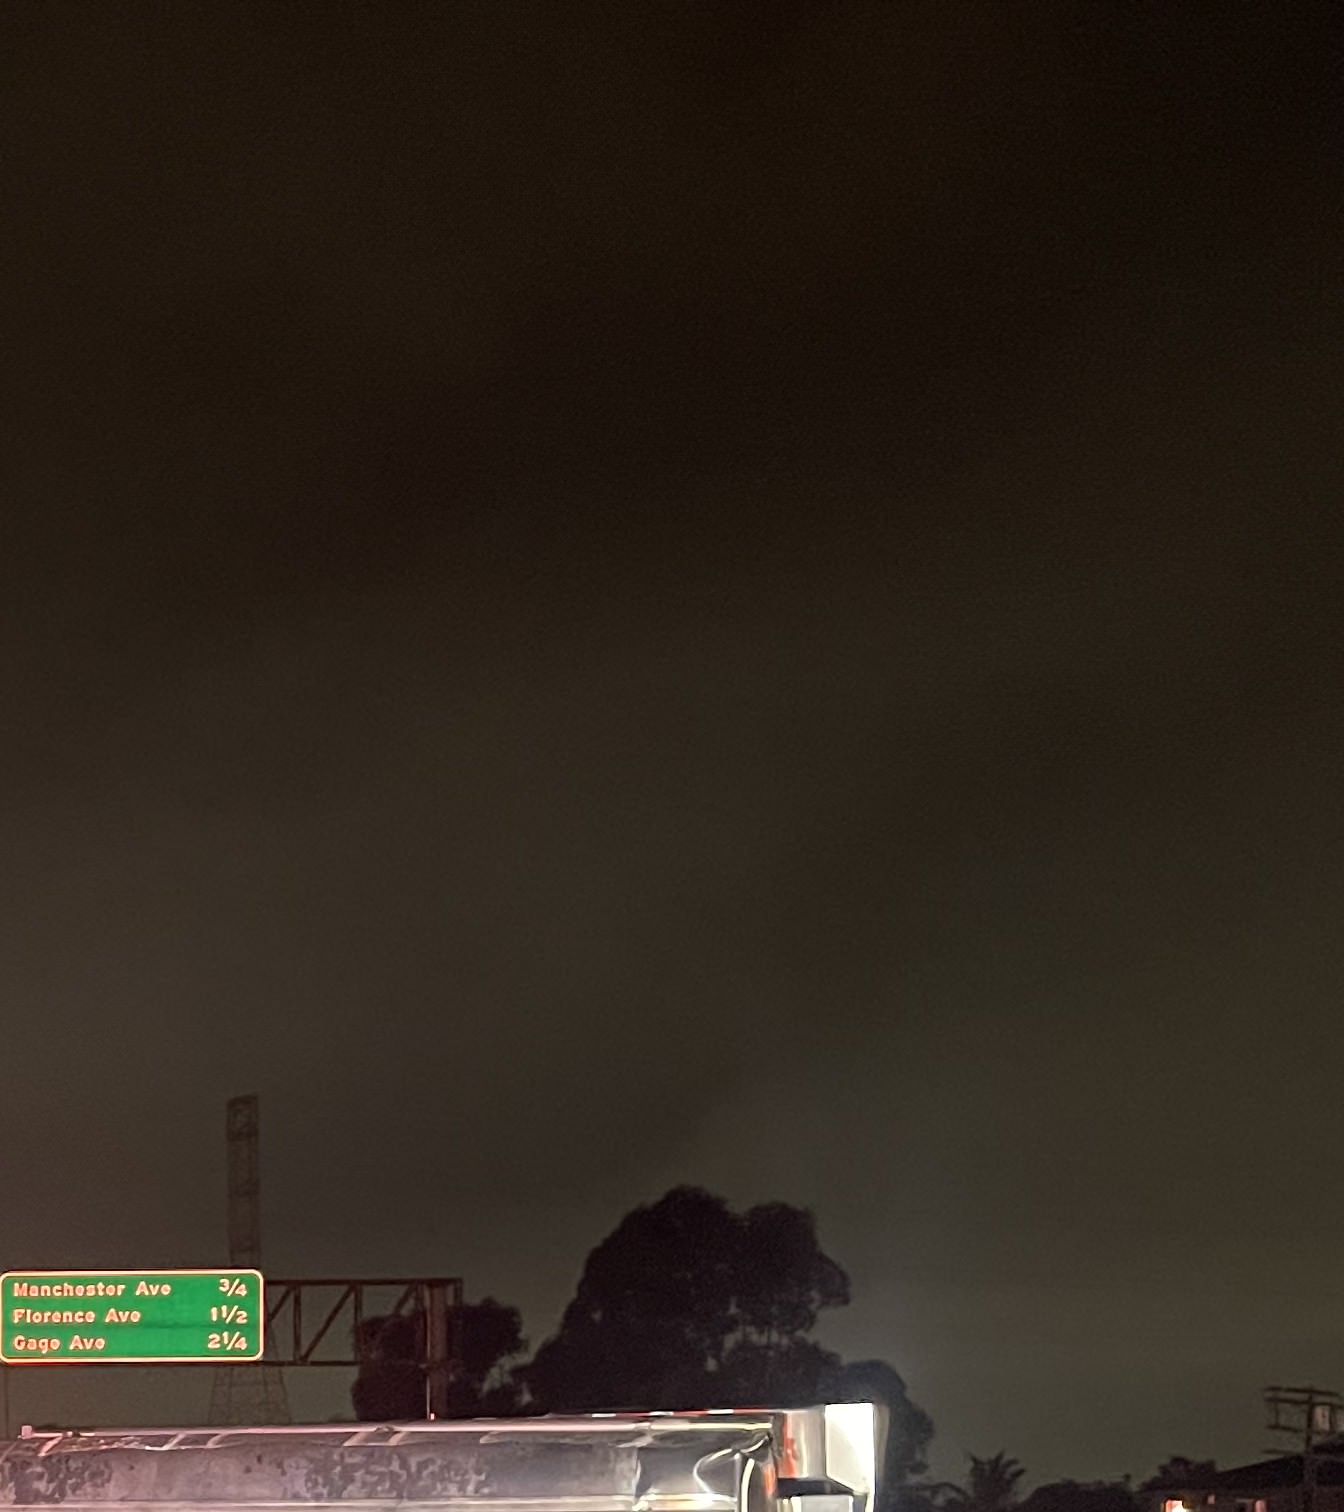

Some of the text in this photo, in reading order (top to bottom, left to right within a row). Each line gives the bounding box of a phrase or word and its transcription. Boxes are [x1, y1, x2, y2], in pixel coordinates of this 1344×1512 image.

[13, 1282, 126, 1296] Manchester
[135, 1281, 171, 1295] Ave
[13, 1309, 96, 1323] Florence
[105, 1308, 141, 1322] Ave
[14, 1335, 60, 1353] Gage
[69, 1335, 105, 1350] Ave
